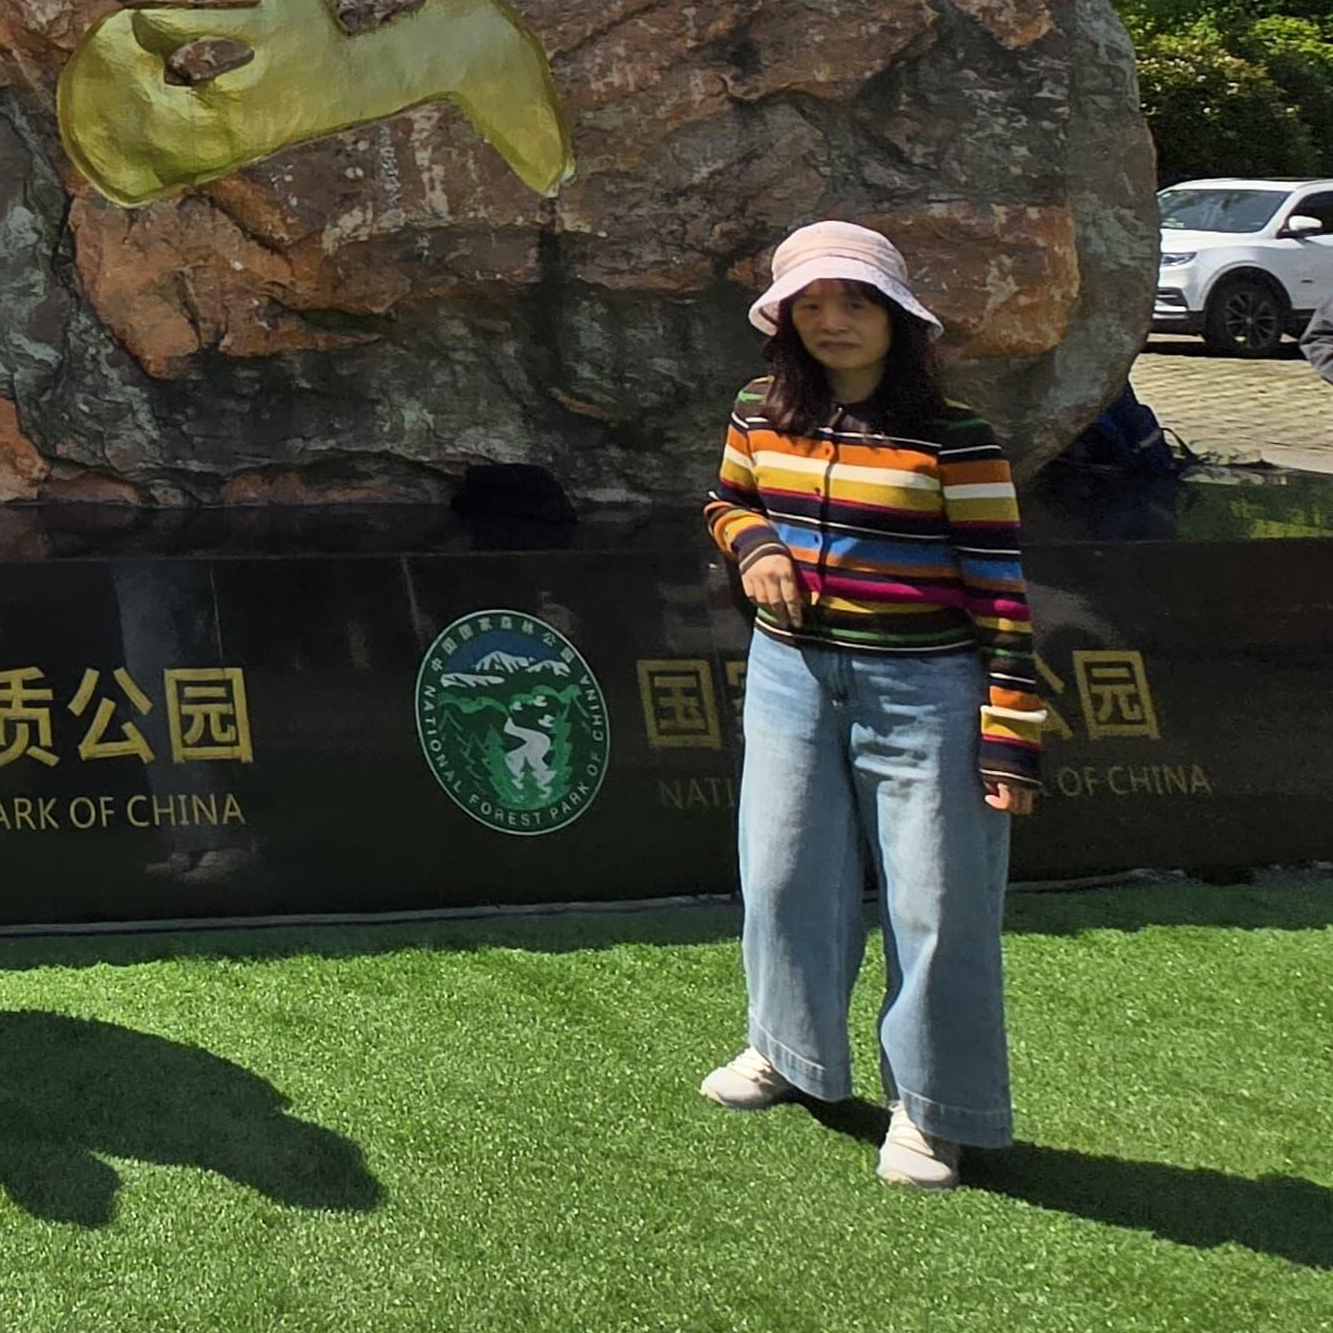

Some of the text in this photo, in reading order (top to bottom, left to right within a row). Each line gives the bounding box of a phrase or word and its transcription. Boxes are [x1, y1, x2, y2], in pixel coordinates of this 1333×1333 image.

[423, 674, 604, 827] NATIONAL FOREST PARK OF CHINA
[1058, 767, 1097, 797] OF
[1107, 764, 1213, 796] CHINA
[69, 796, 115, 829] OF
[127, 793, 246, 827] CHINA
